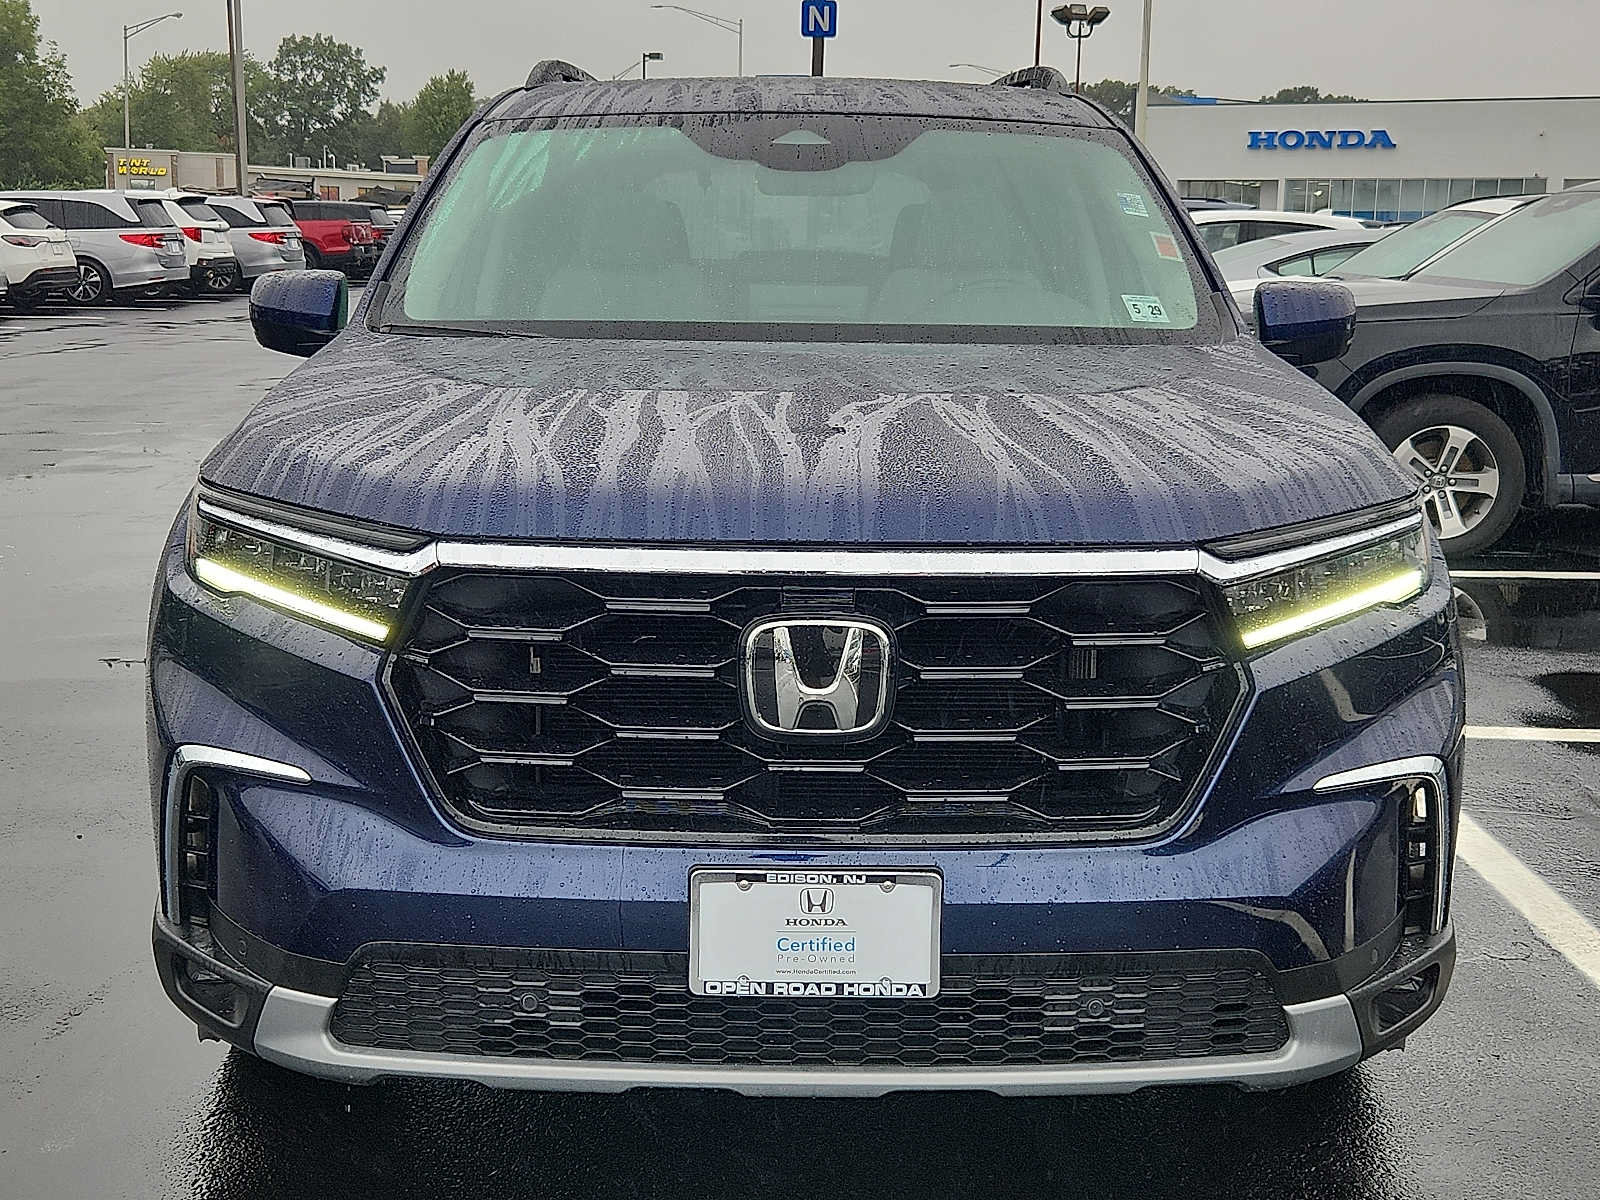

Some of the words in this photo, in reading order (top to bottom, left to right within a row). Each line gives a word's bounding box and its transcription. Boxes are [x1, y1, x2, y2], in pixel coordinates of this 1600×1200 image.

[809, 5, 829, 31] N
[1247, 130, 1396, 150] HONDA
[118, 158, 150, 167] TNT
[1132, 303, 1141, 314] 5
[1147, 305, 1162, 315] 29
[843, 875, 867, 884] NJ
[777, 936, 855, 952] Certified
[777, 954, 855, 963] Pre-Owned
[705, 982, 767, 995] OPEN
[773, 983, 837, 996] ROAD
[843, 983, 924, 997] HONDA
